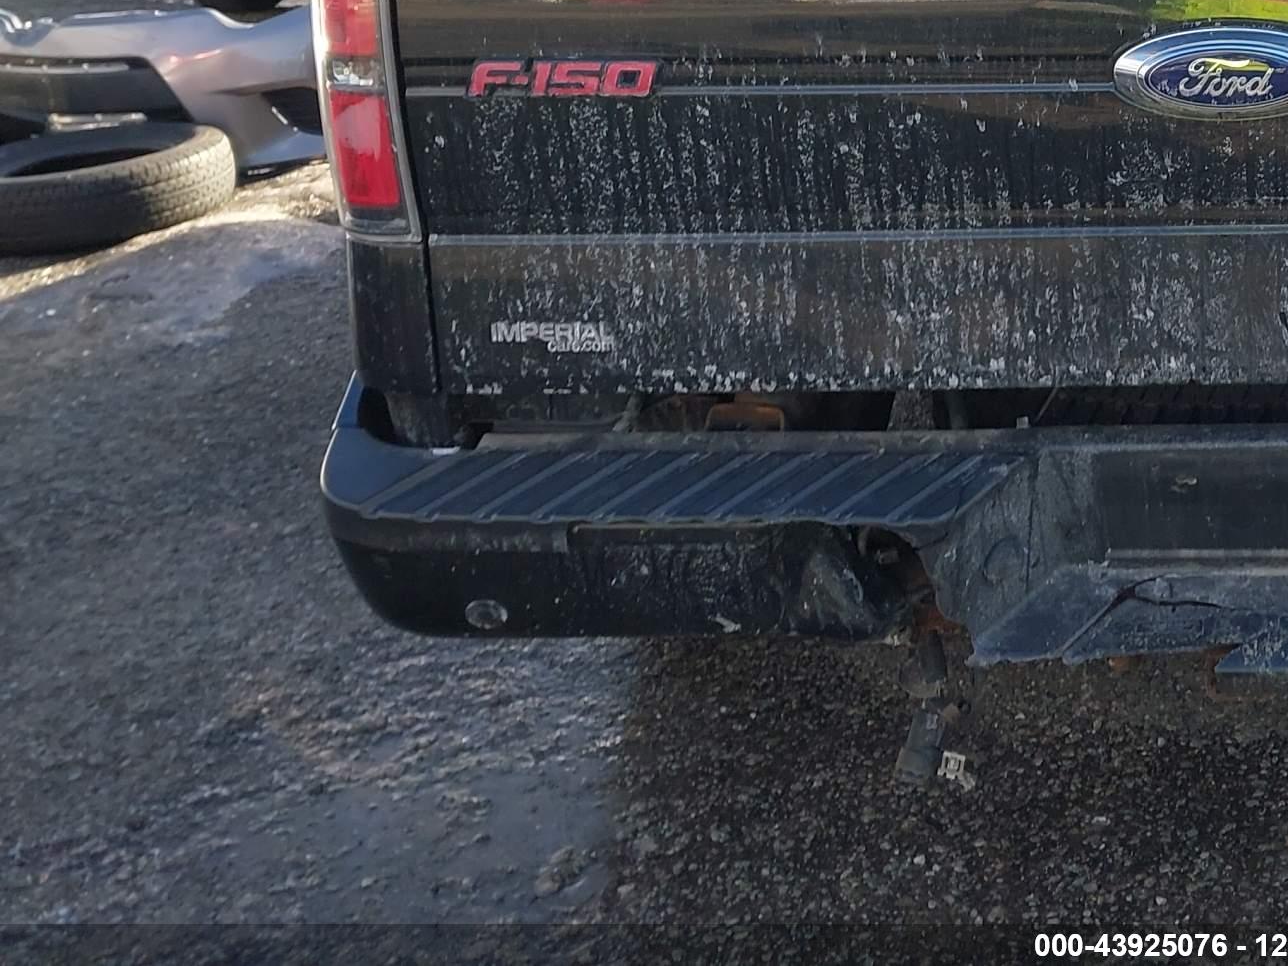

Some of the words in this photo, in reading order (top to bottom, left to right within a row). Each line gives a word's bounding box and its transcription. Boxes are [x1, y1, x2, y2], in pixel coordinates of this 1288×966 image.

[468, 60, 657, 97] F-150
[1179, 57, 1273, 97] Ford
[491, 320, 614, 342] IMPERIAL
